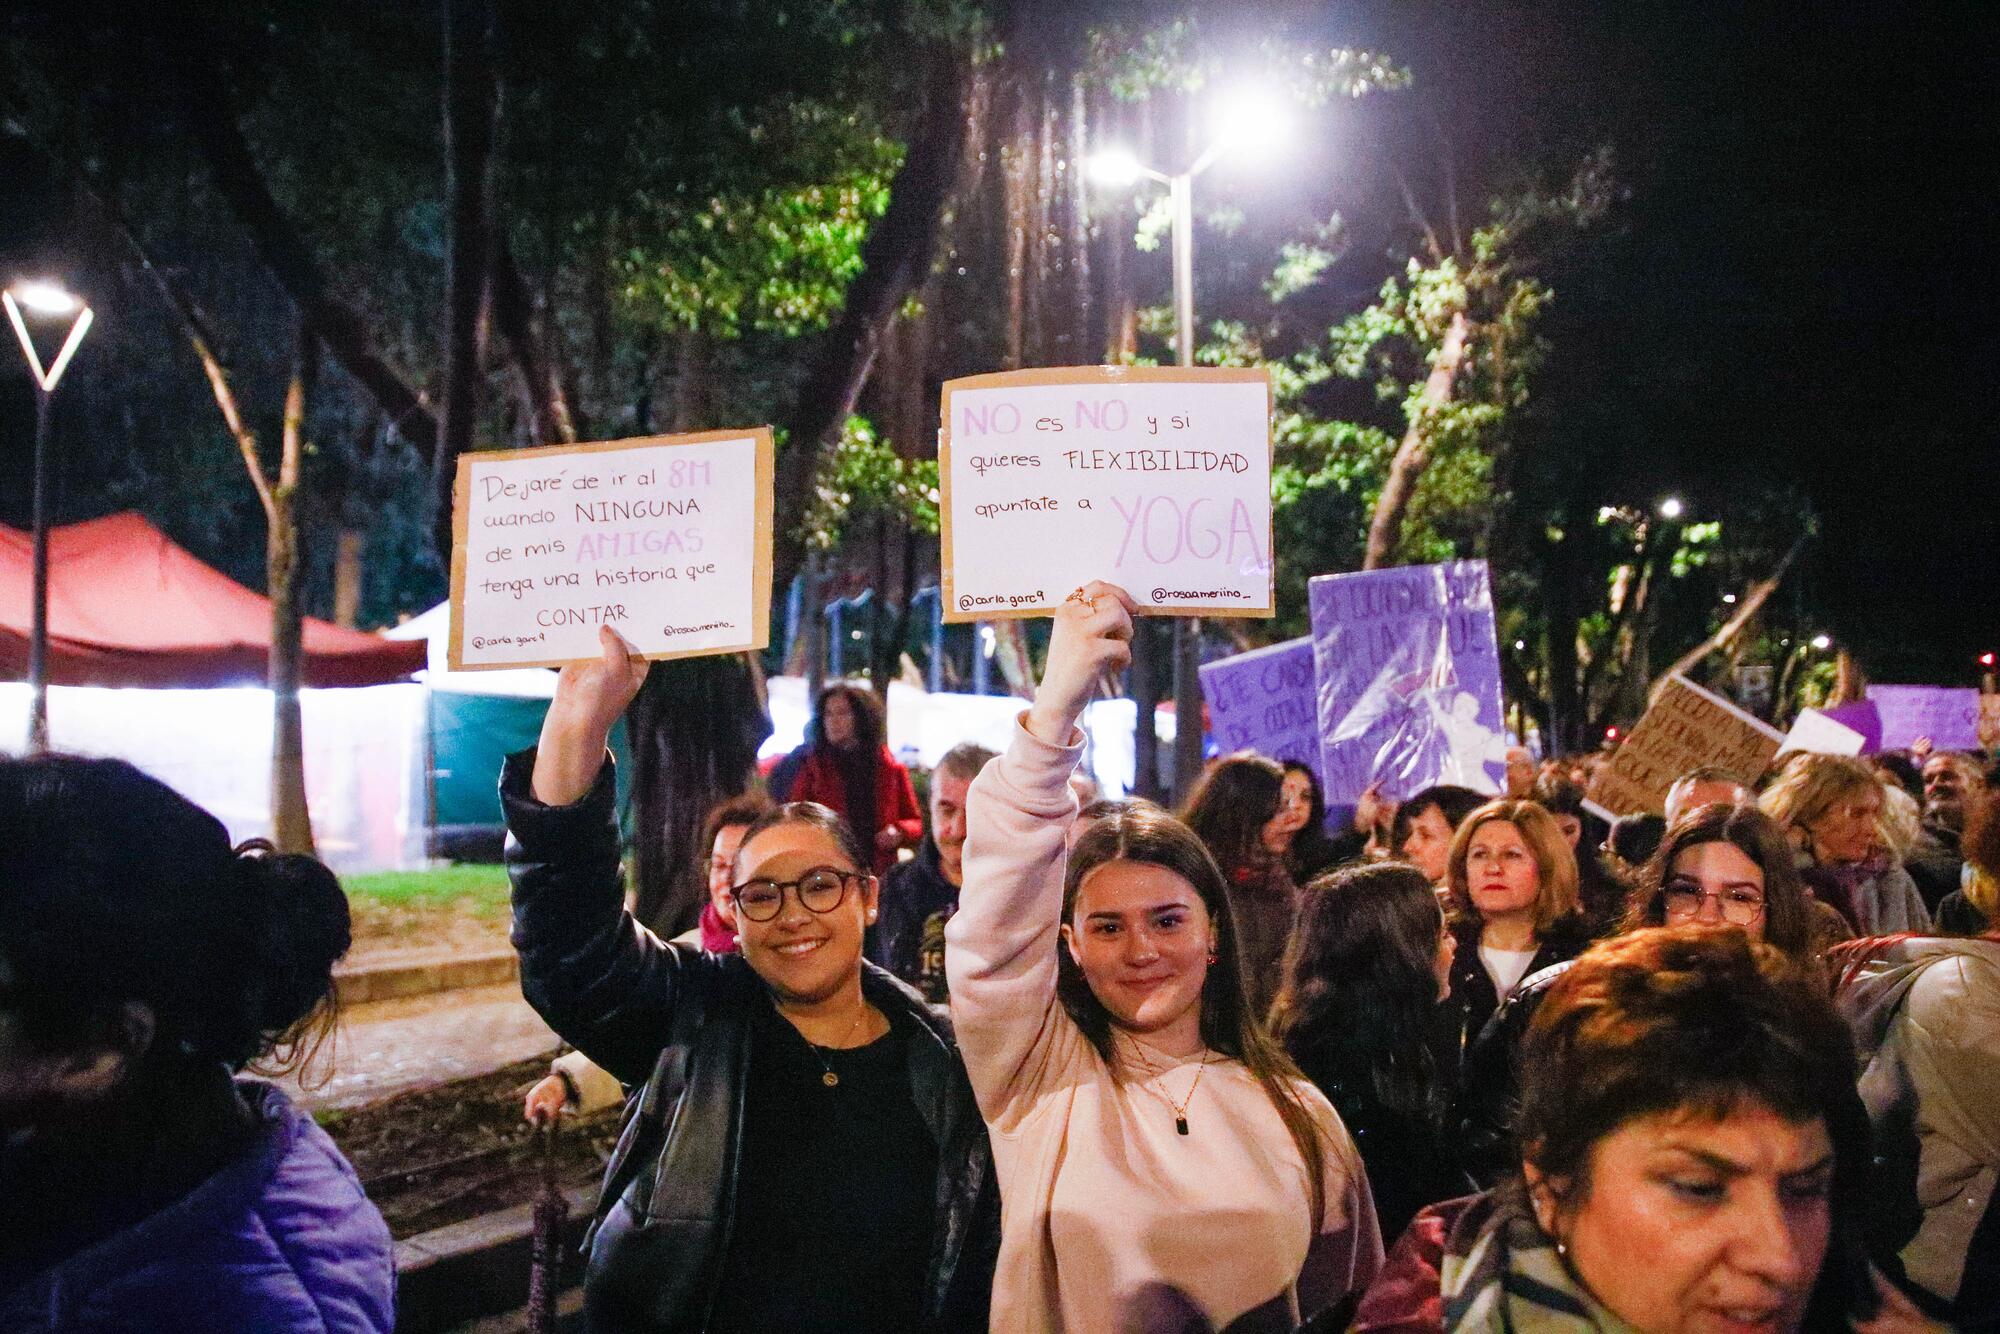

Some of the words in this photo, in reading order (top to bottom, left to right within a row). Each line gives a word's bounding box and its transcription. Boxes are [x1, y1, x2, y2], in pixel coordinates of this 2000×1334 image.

[963, 403, 1022, 436] NO
[1035, 417, 1064, 432] es
[1075, 399, 1129, 431] NO
[1147, 416, 1157, 434] y
[1171, 411, 1190, 429] si
[970, 453, 1041, 476] quieres
[1063, 449, 1248, 473] FLEXIBILIDAD
[480, 469, 567, 501] Dejaré
[572, 475, 598, 490] de
[611, 469, 627, 487] ir
[637, 469, 655, 486] al
[669, 459, 711, 488] 8M
[483, 510, 555, 528] cuando
[575, 499, 700, 523] NINGUNA
[485, 547, 511, 563] de
[525, 540, 565, 556] mis
[576, 528, 703, 563] AMIGAS
[975, 496, 1058, 519] apuntate
[1078, 499, 1091, 510] a
[1110, 495, 1264, 569] YOGA
[479, 577, 534, 600] tenga
[544, 573, 580, 586] una
[596, 566, 678, 586] historia
[686, 563, 715, 580] que
[1151, 587, 1251, 603] @rosaameriino_
[536, 604, 629, 628] CONTAR
[959, 590, 1044, 611] @carla.garc9
